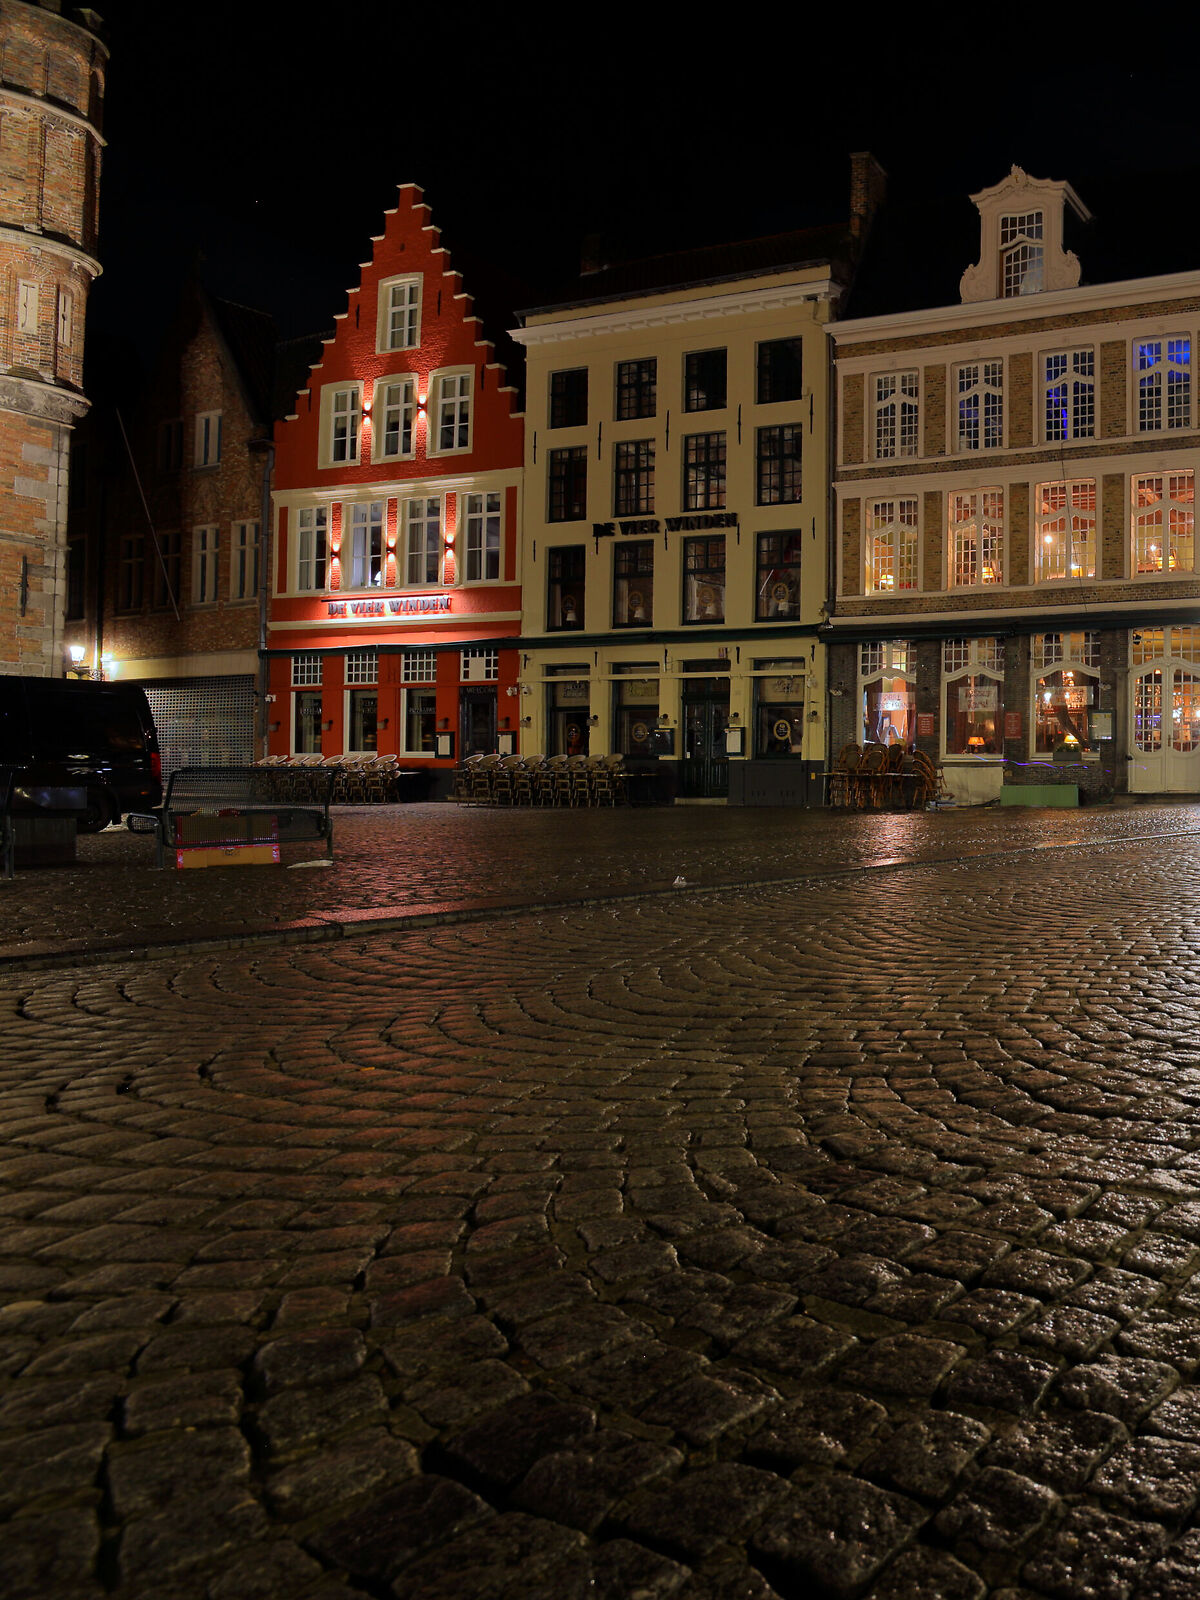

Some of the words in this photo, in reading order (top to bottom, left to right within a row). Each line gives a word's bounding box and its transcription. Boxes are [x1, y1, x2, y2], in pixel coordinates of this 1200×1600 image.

[593, 522, 615, 537] DE
[619, 519, 660, 535] VIER
[665, 513, 738, 532] WINDEN
[328, 603, 346, 615] DE
[351, 601, 384, 614] VIER
[389, 598, 452, 612] WINDEN
